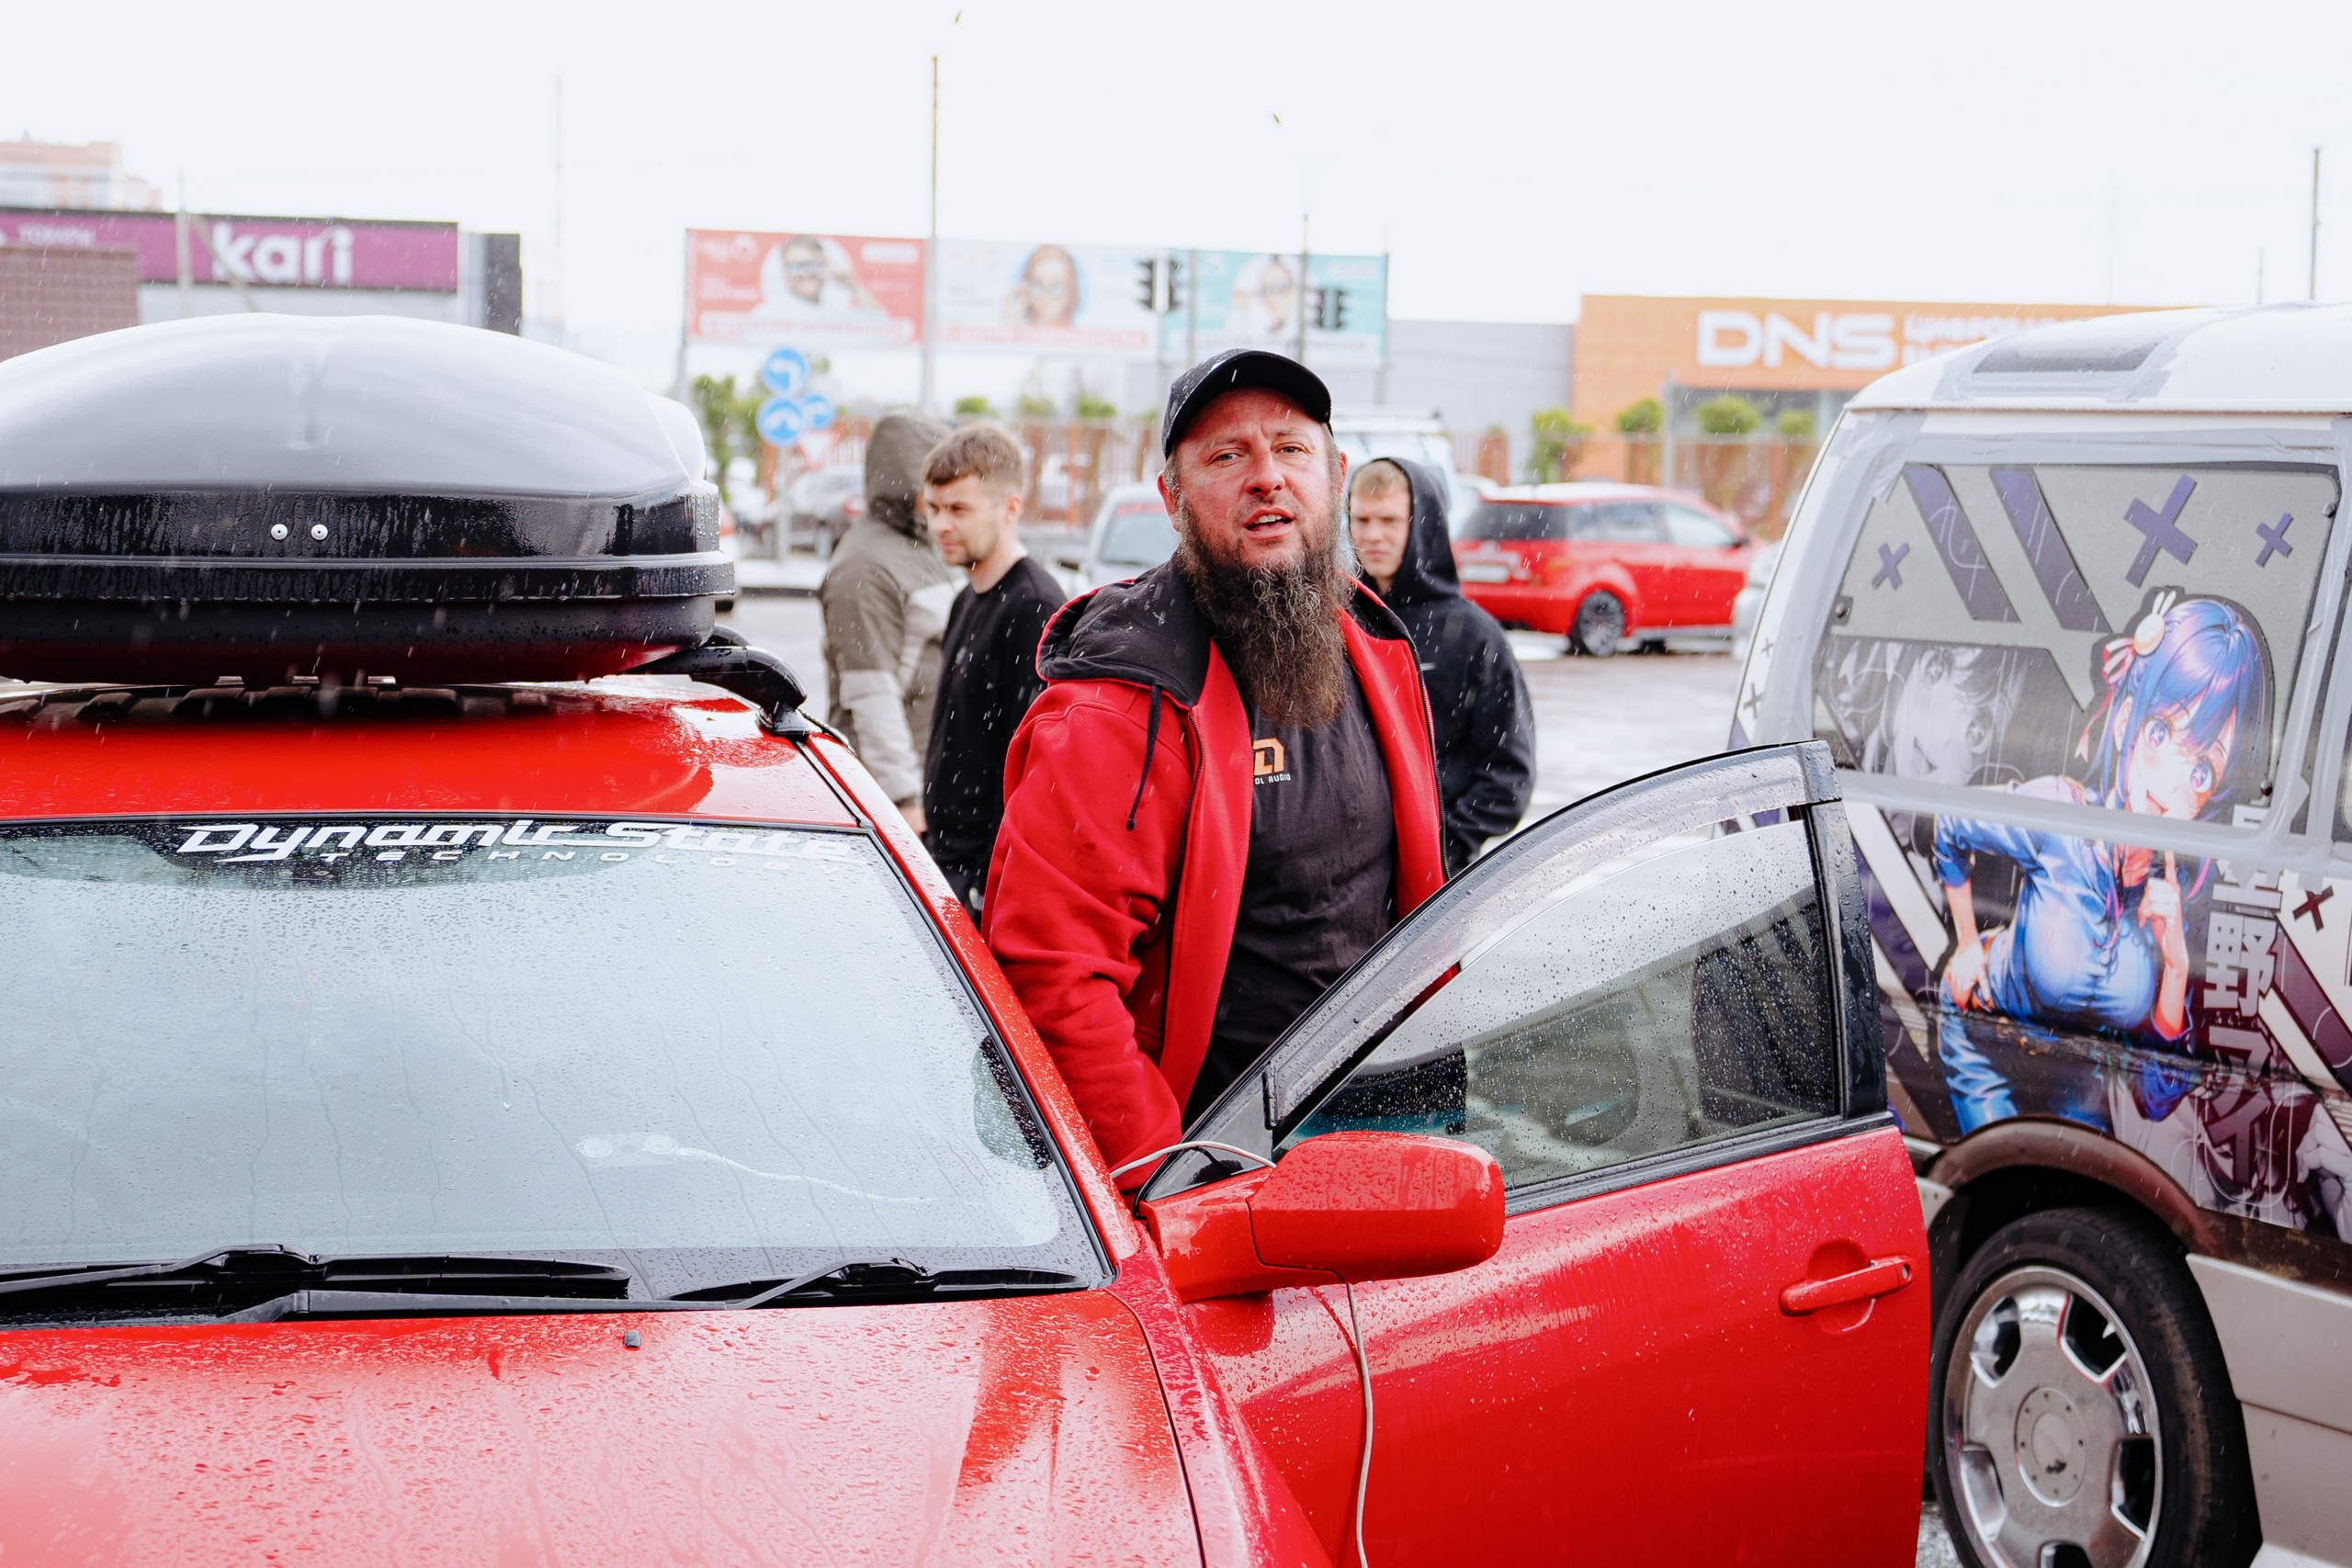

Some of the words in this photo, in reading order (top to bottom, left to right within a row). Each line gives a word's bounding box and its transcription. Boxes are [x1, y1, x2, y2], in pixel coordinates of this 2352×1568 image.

[212, 221, 355, 284] kari
[1697, 310, 1898, 370] DNS
[1268, 773, 1291, 783] AUDIO
